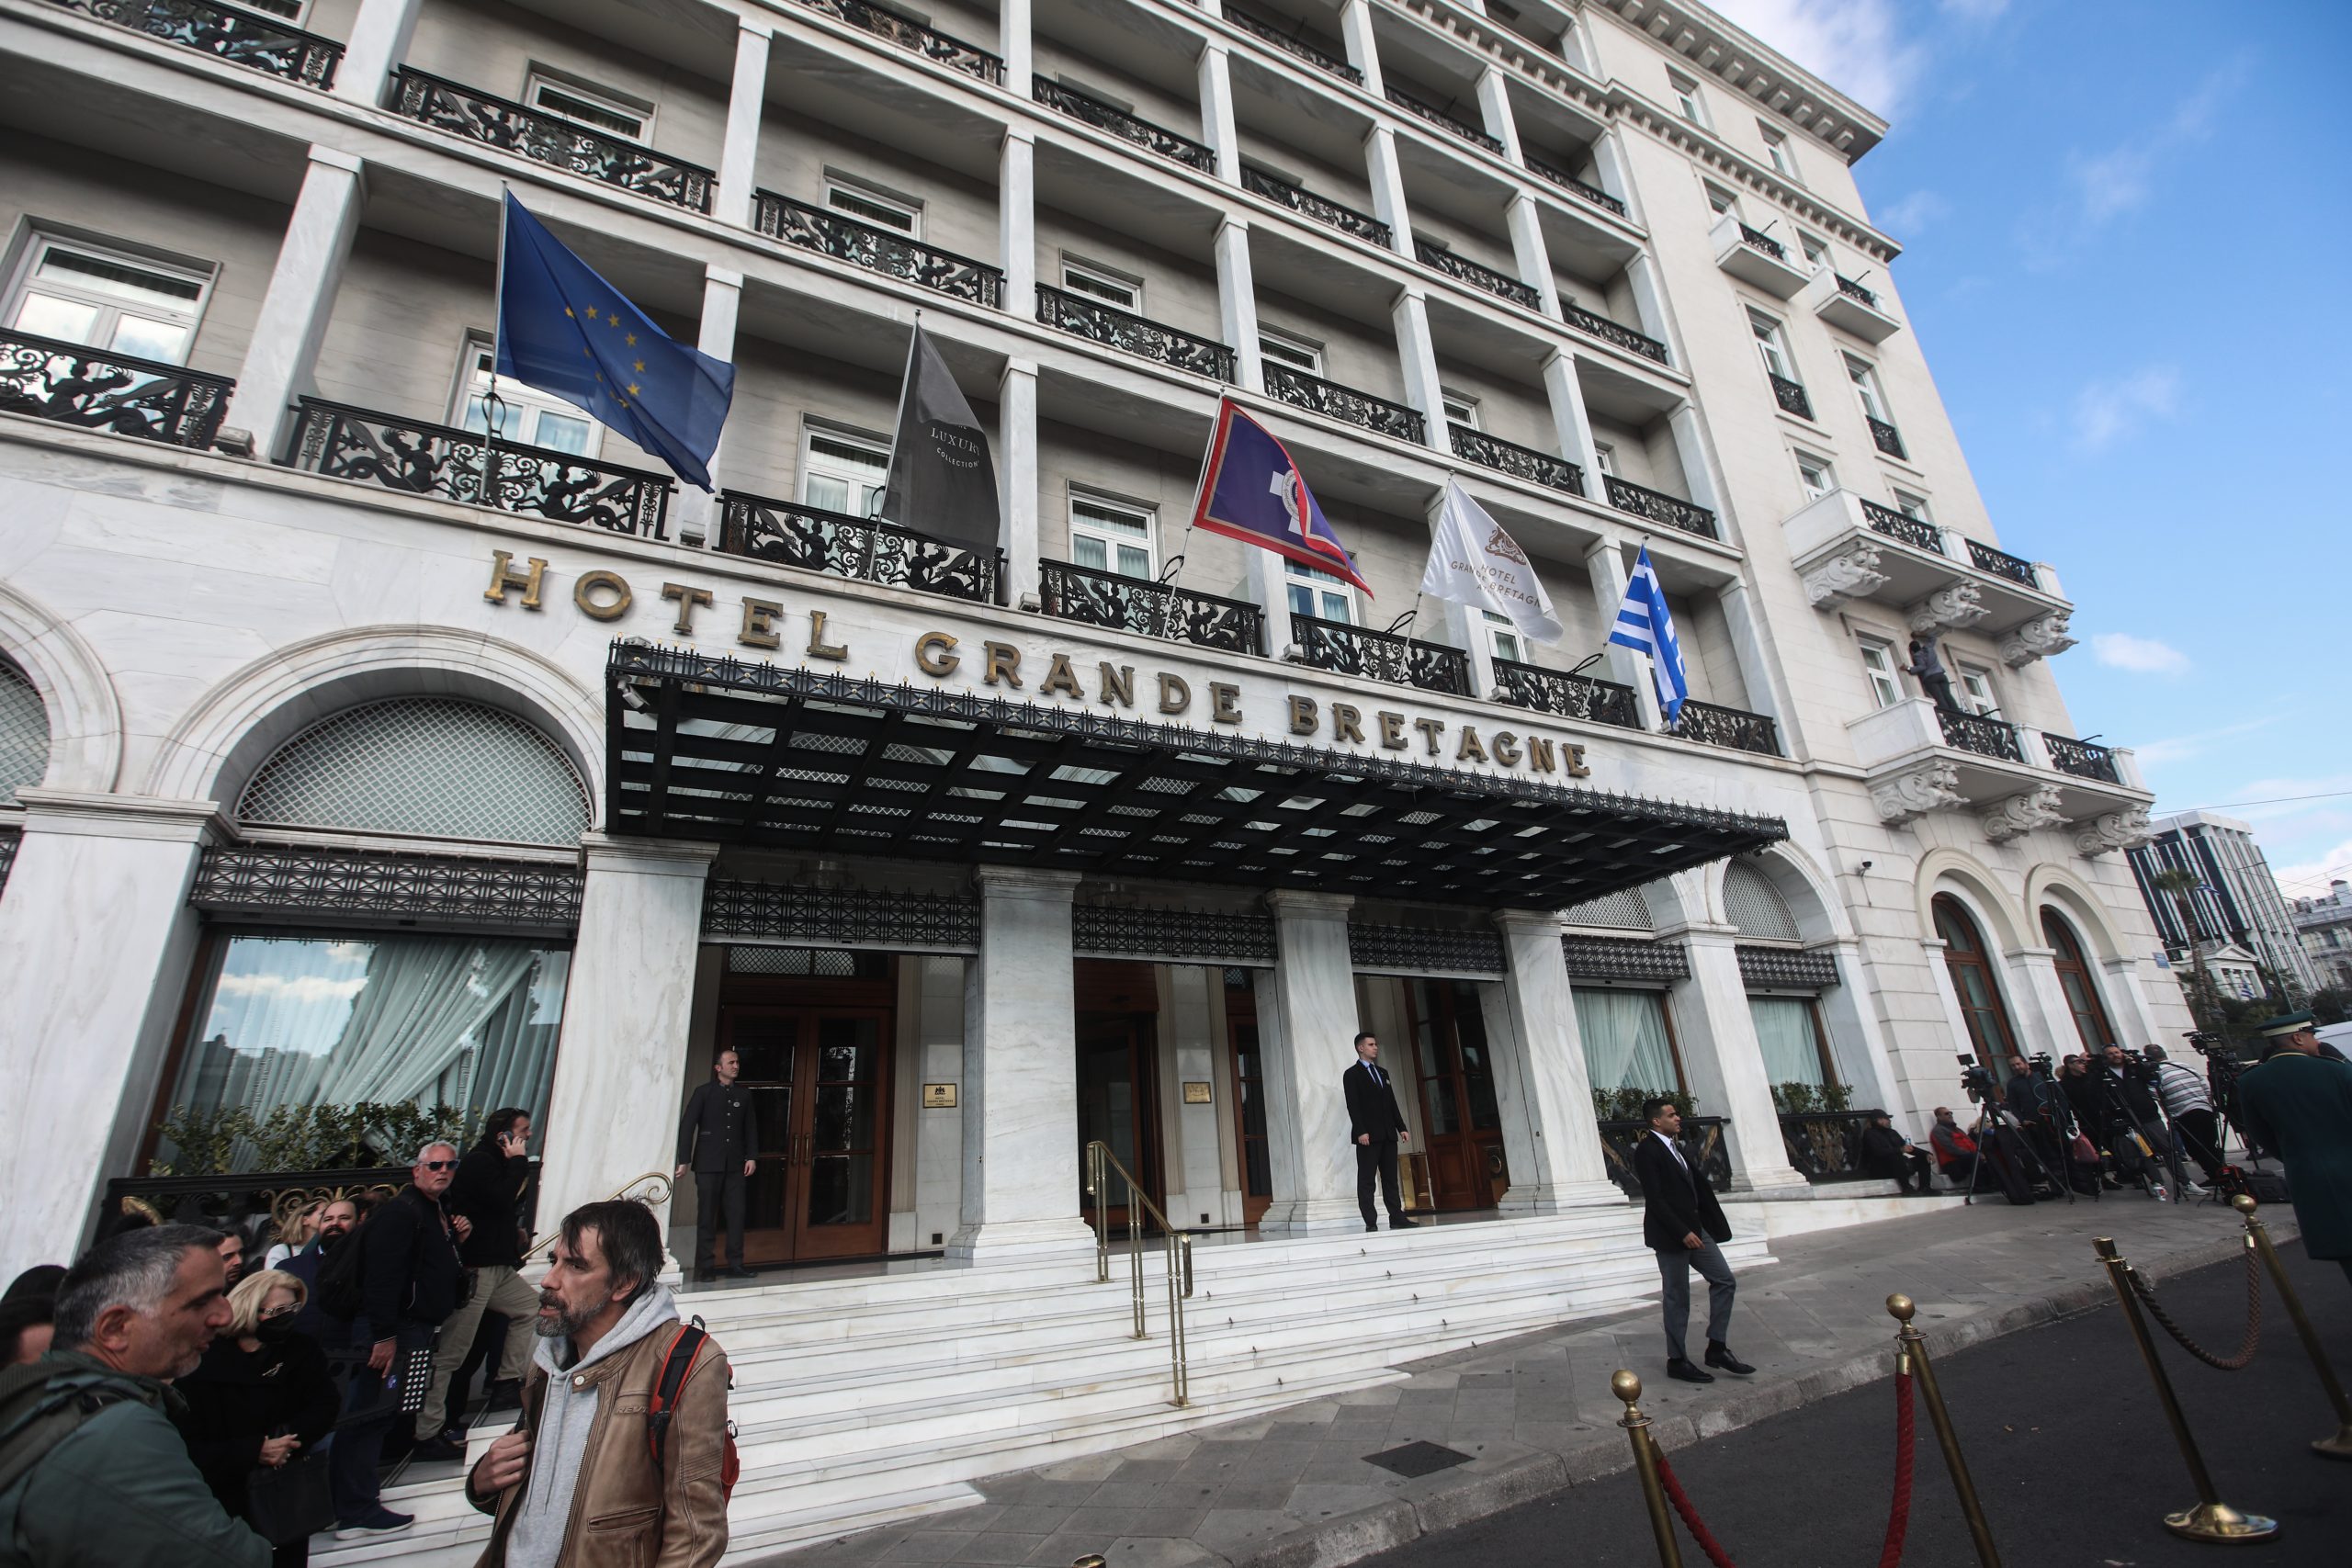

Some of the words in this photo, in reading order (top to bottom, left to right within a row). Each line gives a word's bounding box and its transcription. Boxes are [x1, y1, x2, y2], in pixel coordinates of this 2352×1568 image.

[937, 447, 978, 468] COLLECTION
[1451, 560, 1487, 581] GRANDE
[1489, 581, 1541, 607] BRETAGN
[1481, 563, 1515, 584] HOTEL
[483, 549, 848, 660] HOTEL
[914, 631, 1243, 724] GRANDE
[1287, 694, 1590, 778] BRETAGNE
